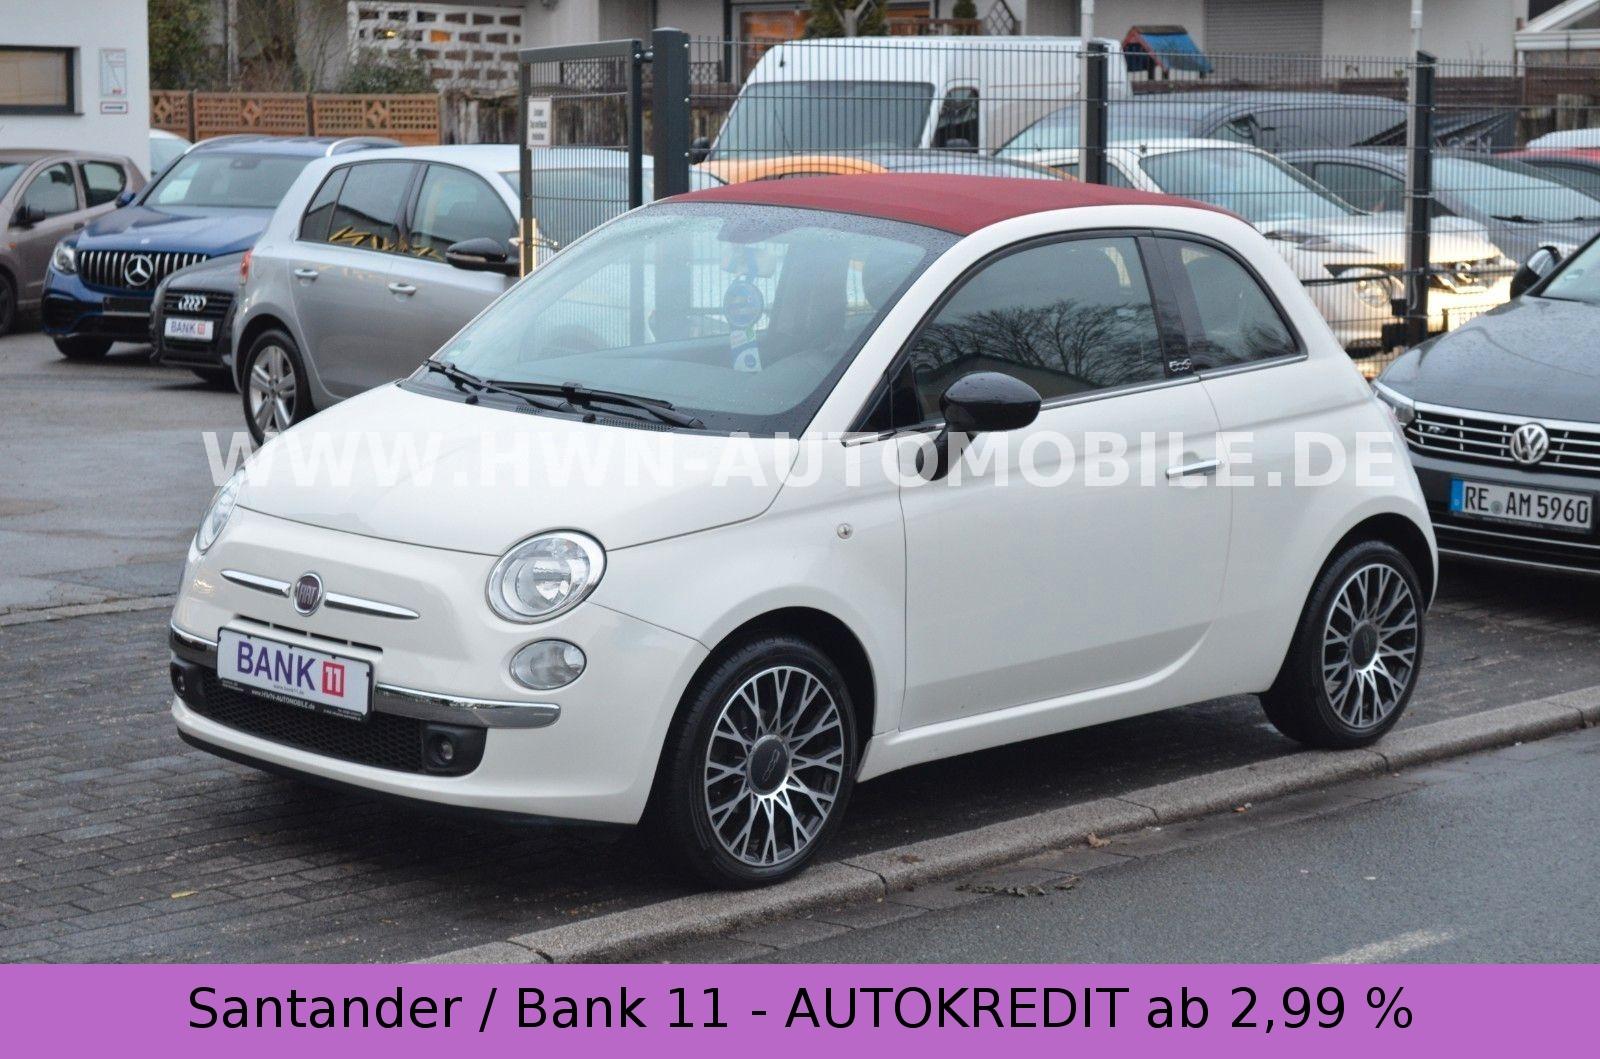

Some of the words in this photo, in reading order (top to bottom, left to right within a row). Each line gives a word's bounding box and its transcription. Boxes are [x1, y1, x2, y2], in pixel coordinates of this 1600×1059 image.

[1465, 486, 1489, 511] RE
[1506, 491, 1531, 517] AM
[1537, 495, 1589, 523] 5960
[237, 640, 316, 691] BANK
[324, 664, 343, 695] 11
